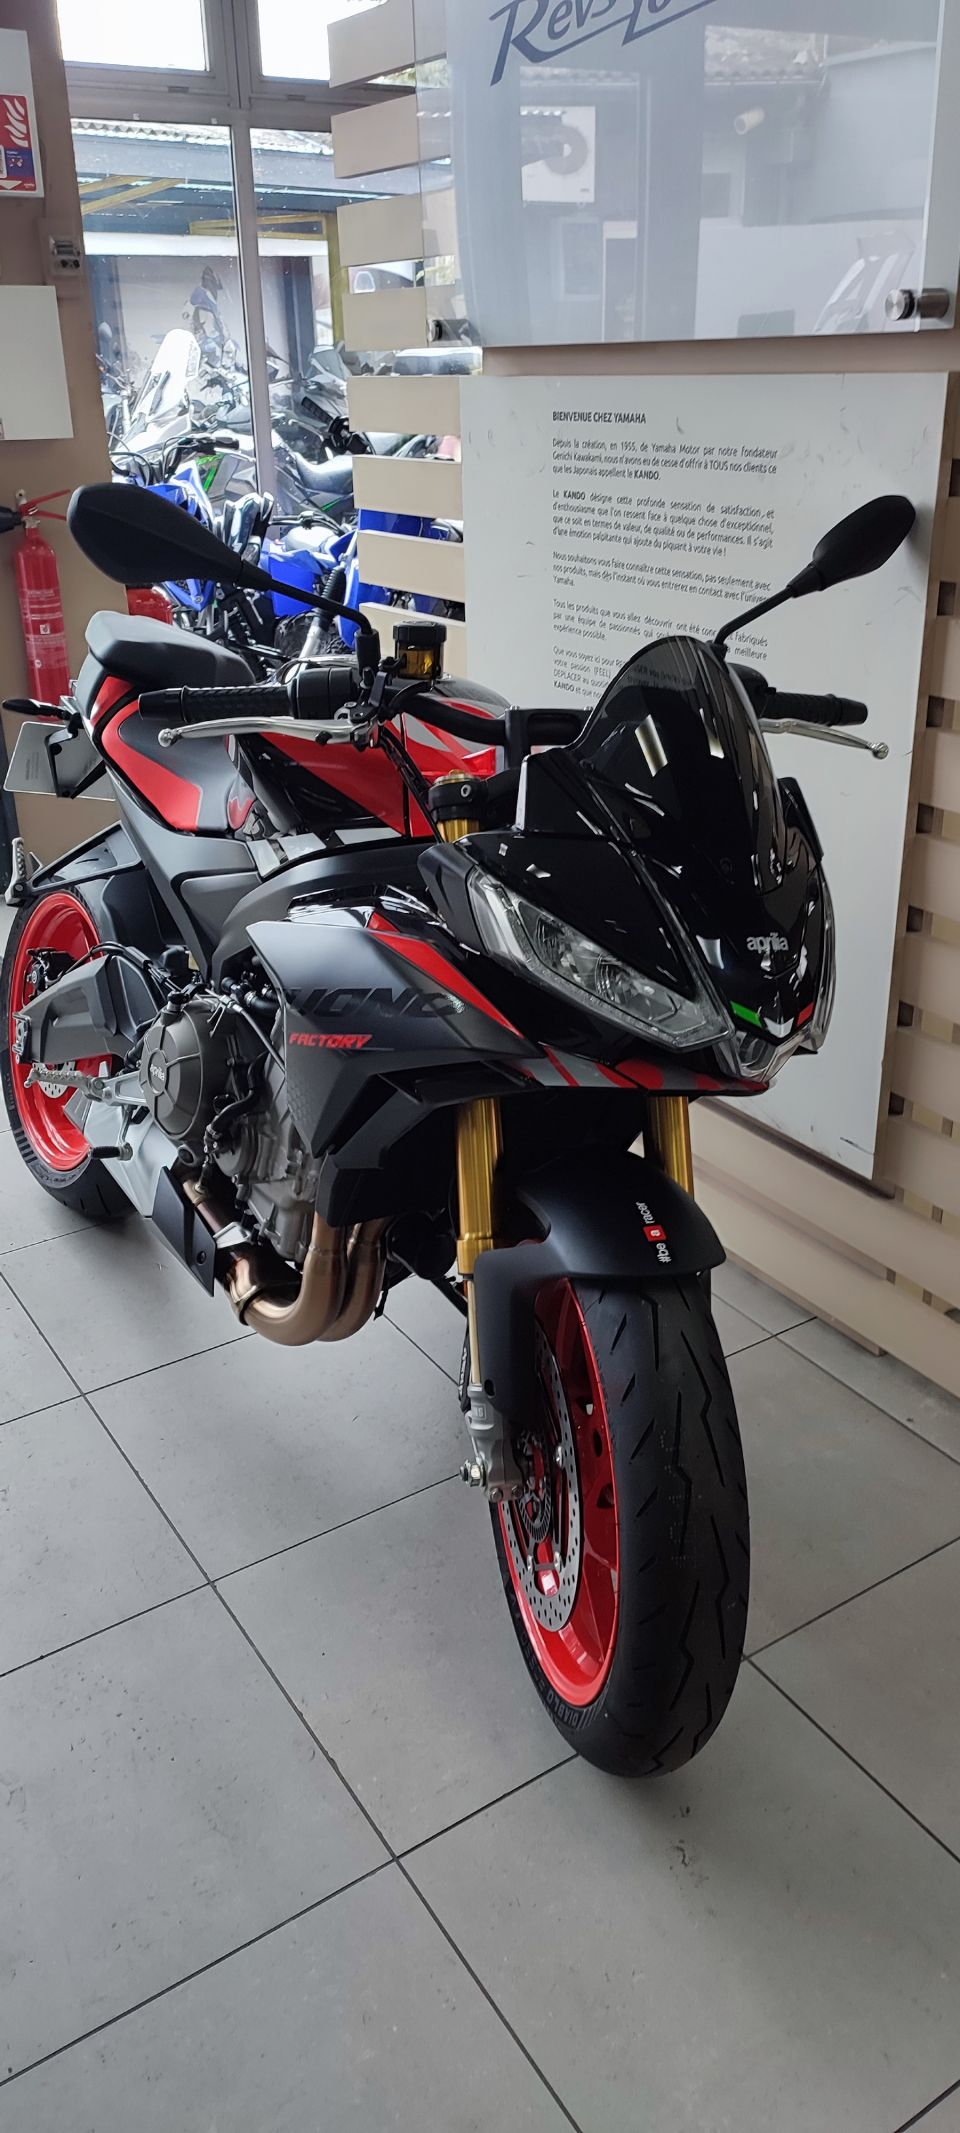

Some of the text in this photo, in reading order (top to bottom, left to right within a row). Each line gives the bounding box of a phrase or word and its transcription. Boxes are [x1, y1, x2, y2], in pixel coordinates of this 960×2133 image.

[553, 411, 646, 424] BIENVENUE CHEZ YAMAHA
[553, 438, 778, 459] Depuis la création, en 1955, de Yamaha Motor par notre fondateur
[604, 456, 618, 464] nous
[620, 456, 641, 465] n'avons
[643, 458, 650, 466] eu
[652, 457, 660, 466] de
[661, 458, 678, 468] cesse
[679, 458, 702, 470] d'offrir
[704, 460, 708, 470] à
[710, 460, 728, 471] TOUS
[730, 463, 742, 472] nos
[743, 462, 767, 474] clients
[768, 464, 776, 474] ce
[552, 490, 560, 498] Le
[563, 490, 586, 500] KANDO
[590, 492, 612, 504] désigne
[616, 496, 632, 506] cette
[636, 496, 666, 508] profonde
[670, 500, 702, 512] sensation
[706, 502, 715, 513] de
[766, 510, 774, 519] et
[734, 647, 768, 660] meilleure
[554, 681, 574, 692] KANDO
[746, 932, 789, 954] aprilia
[288, 1032, 373, 1049] FACTORY
[635, 1201, 656, 1224] racer
[656, 1242, 672, 1263] #be
